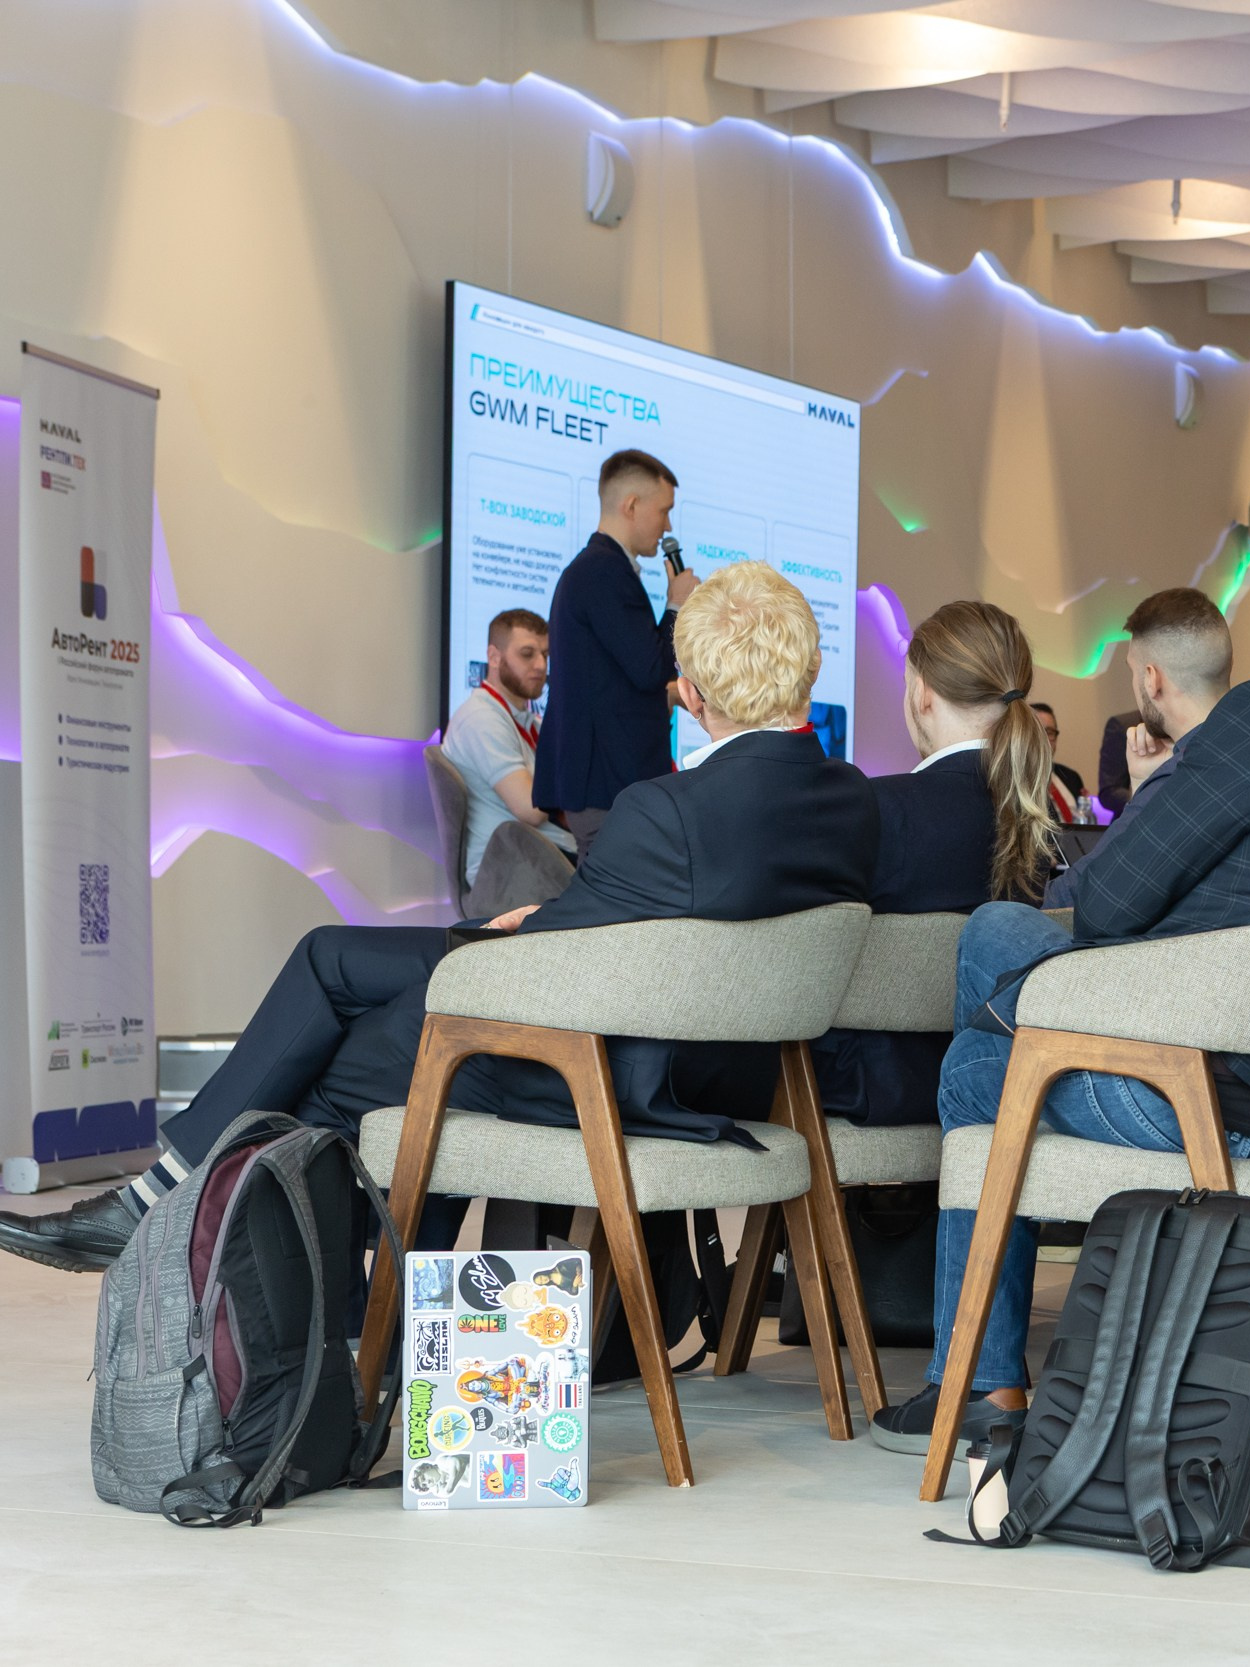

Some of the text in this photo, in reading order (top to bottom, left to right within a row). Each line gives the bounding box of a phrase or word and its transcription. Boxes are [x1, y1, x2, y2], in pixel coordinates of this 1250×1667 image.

[468, 352, 662, 426] ПРЕИМУЩЕСТВА
[469, 389, 610, 446] GWM FLEET
[807, 401, 856, 429] HAVAL
[40, 418, 82, 444] HAVAL
[510, 503, 567, 527] ЗАВОДСКОЙ
[781, 559, 843, 584] ЭФФЕКТИВНОСТЬ
[110, 638, 141, 664] 2025
[457, 1313, 500, 1334] ONE
[499, 1313, 507, 1333] LOVE
